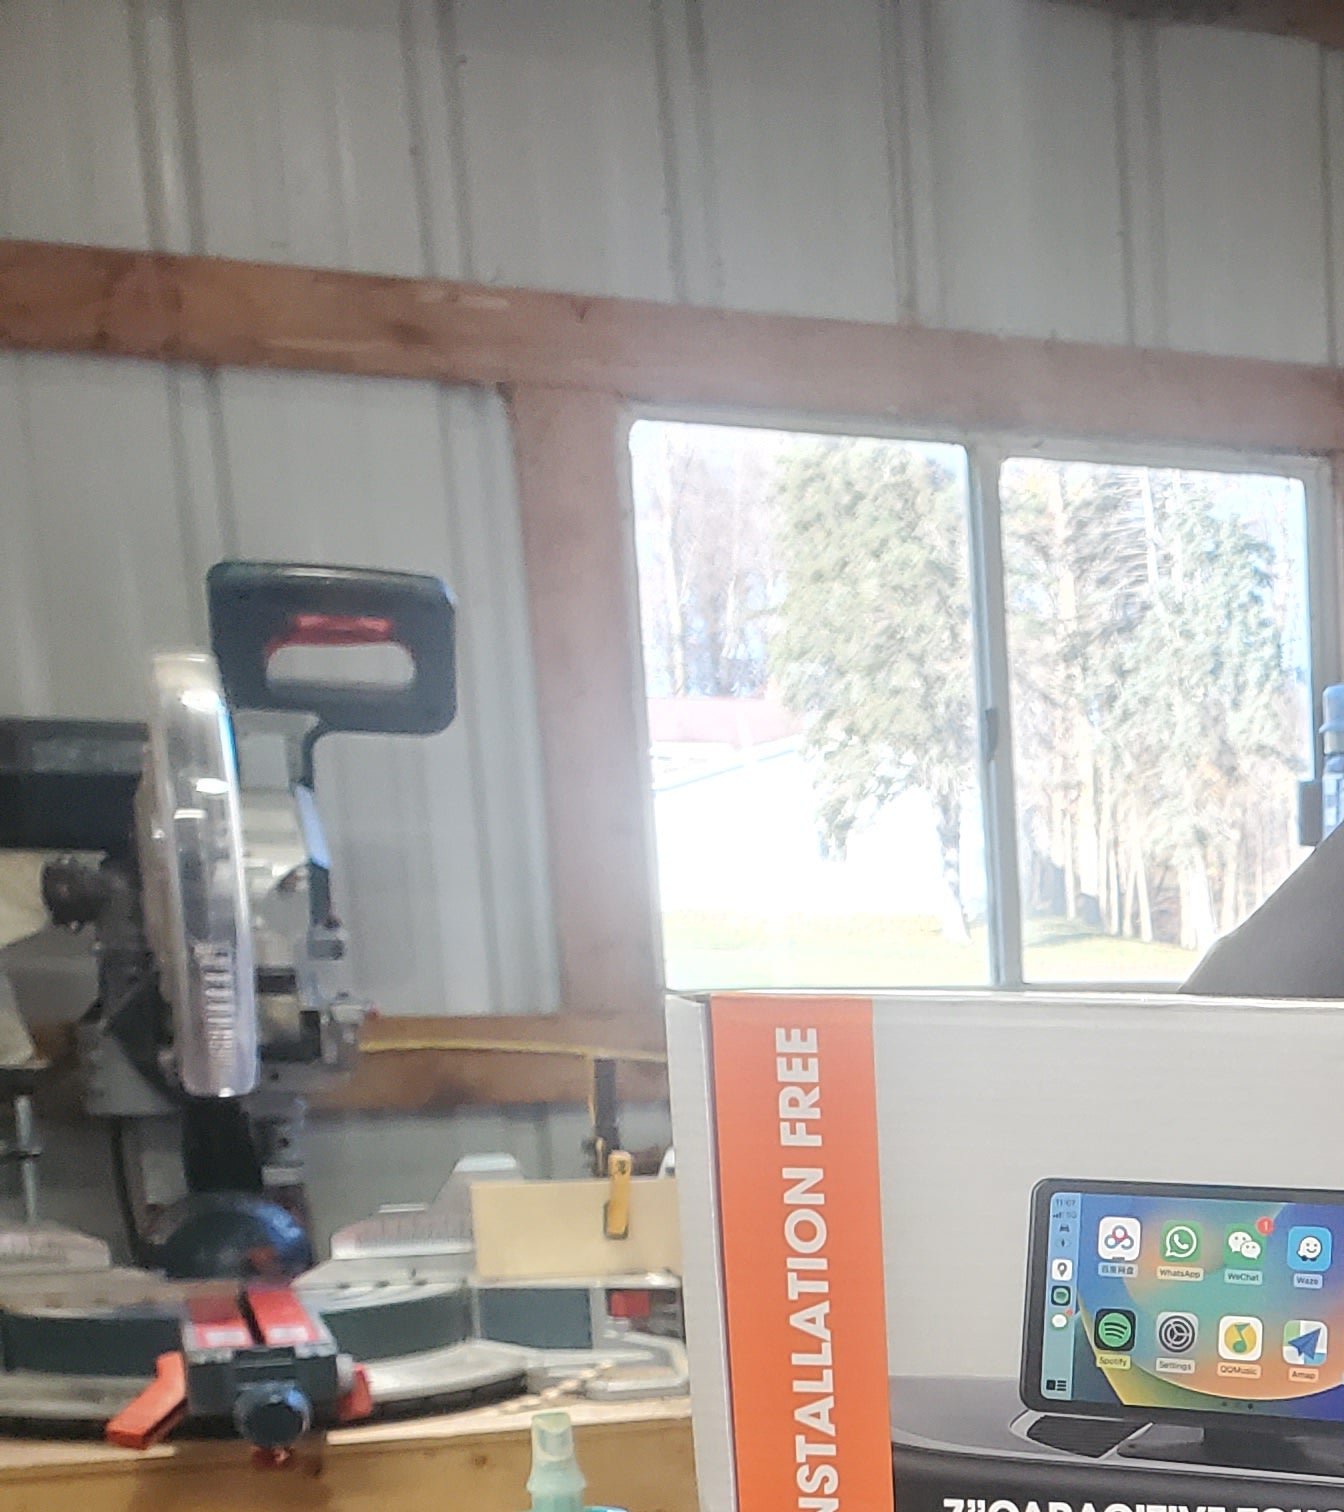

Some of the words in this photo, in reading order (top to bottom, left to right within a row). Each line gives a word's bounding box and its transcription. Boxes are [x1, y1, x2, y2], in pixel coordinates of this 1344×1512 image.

[774, 1024, 822, 1147] FREE
[1159, 1268, 1201, 1279] WhatsApp
[1227, 1271, 1259, 1281] WeChat
[1296, 1276, 1319, 1285] Waze
[1099, 1355, 1128, 1366] Spotify
[1158, 1359, 1192, 1371] Settings
